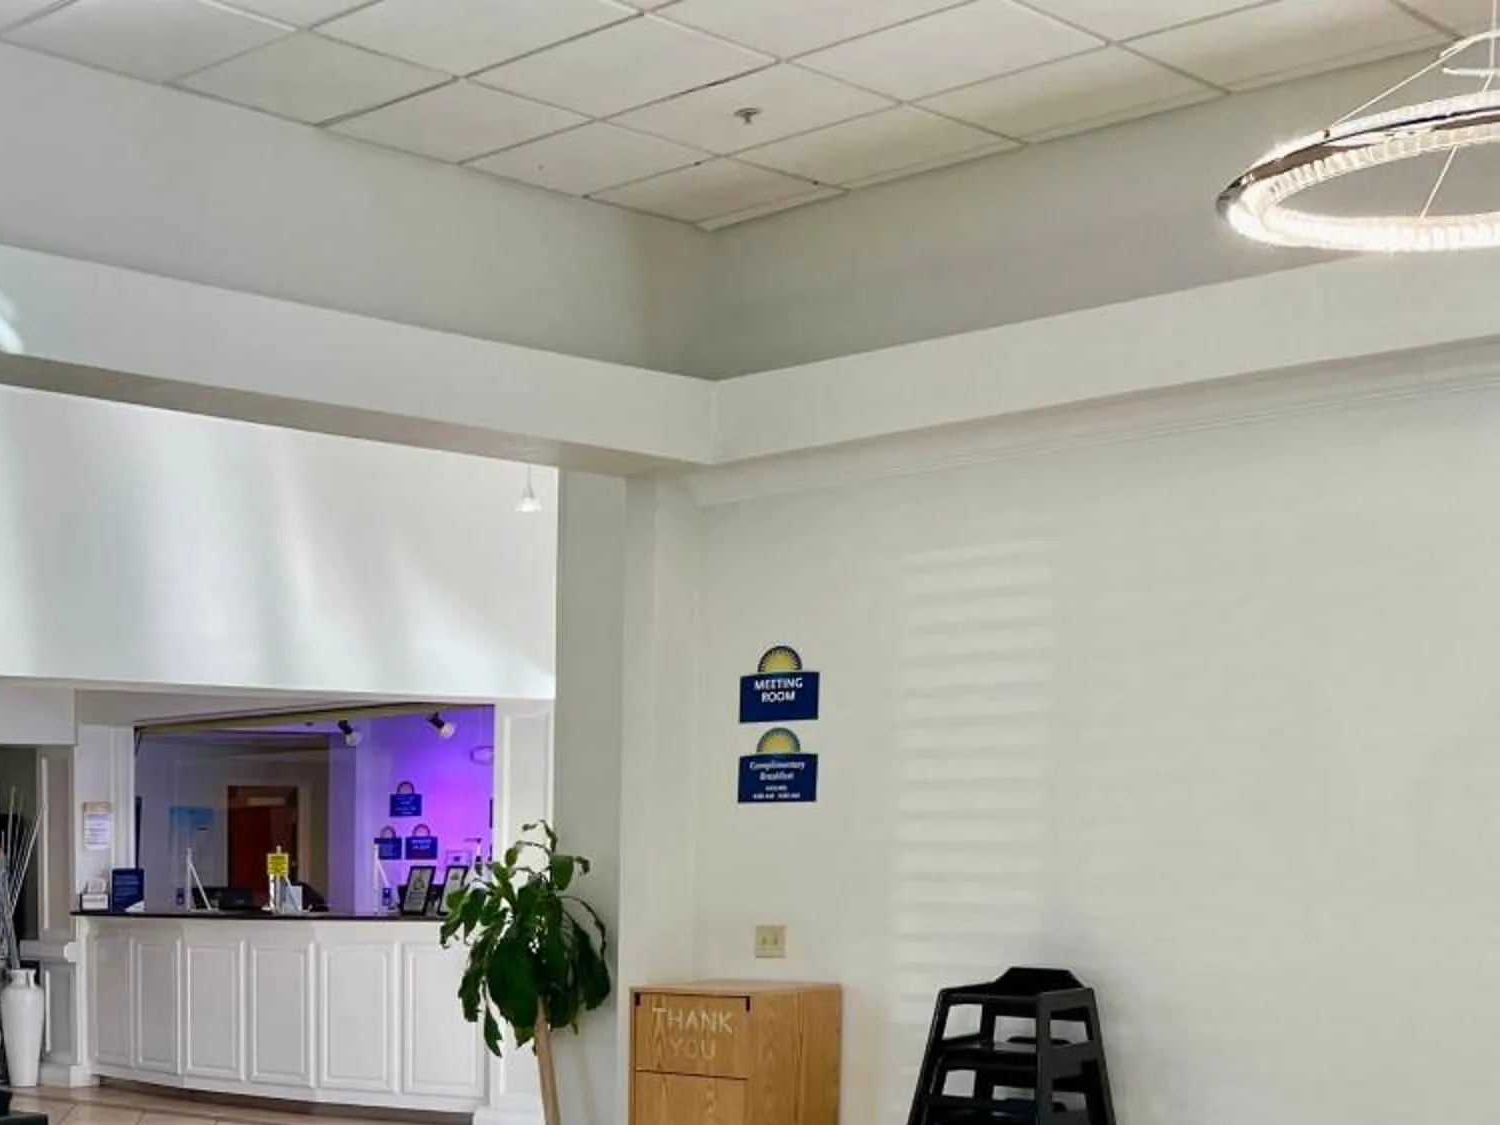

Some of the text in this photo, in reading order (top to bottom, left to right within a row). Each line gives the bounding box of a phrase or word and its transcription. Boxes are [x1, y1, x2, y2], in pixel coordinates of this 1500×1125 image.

[754, 677, 803, 690] MEETING
[761, 691, 796, 703] ROOM
[651, 1007, 734, 1034] THANK
[668, 1038, 716, 1060] YOU
